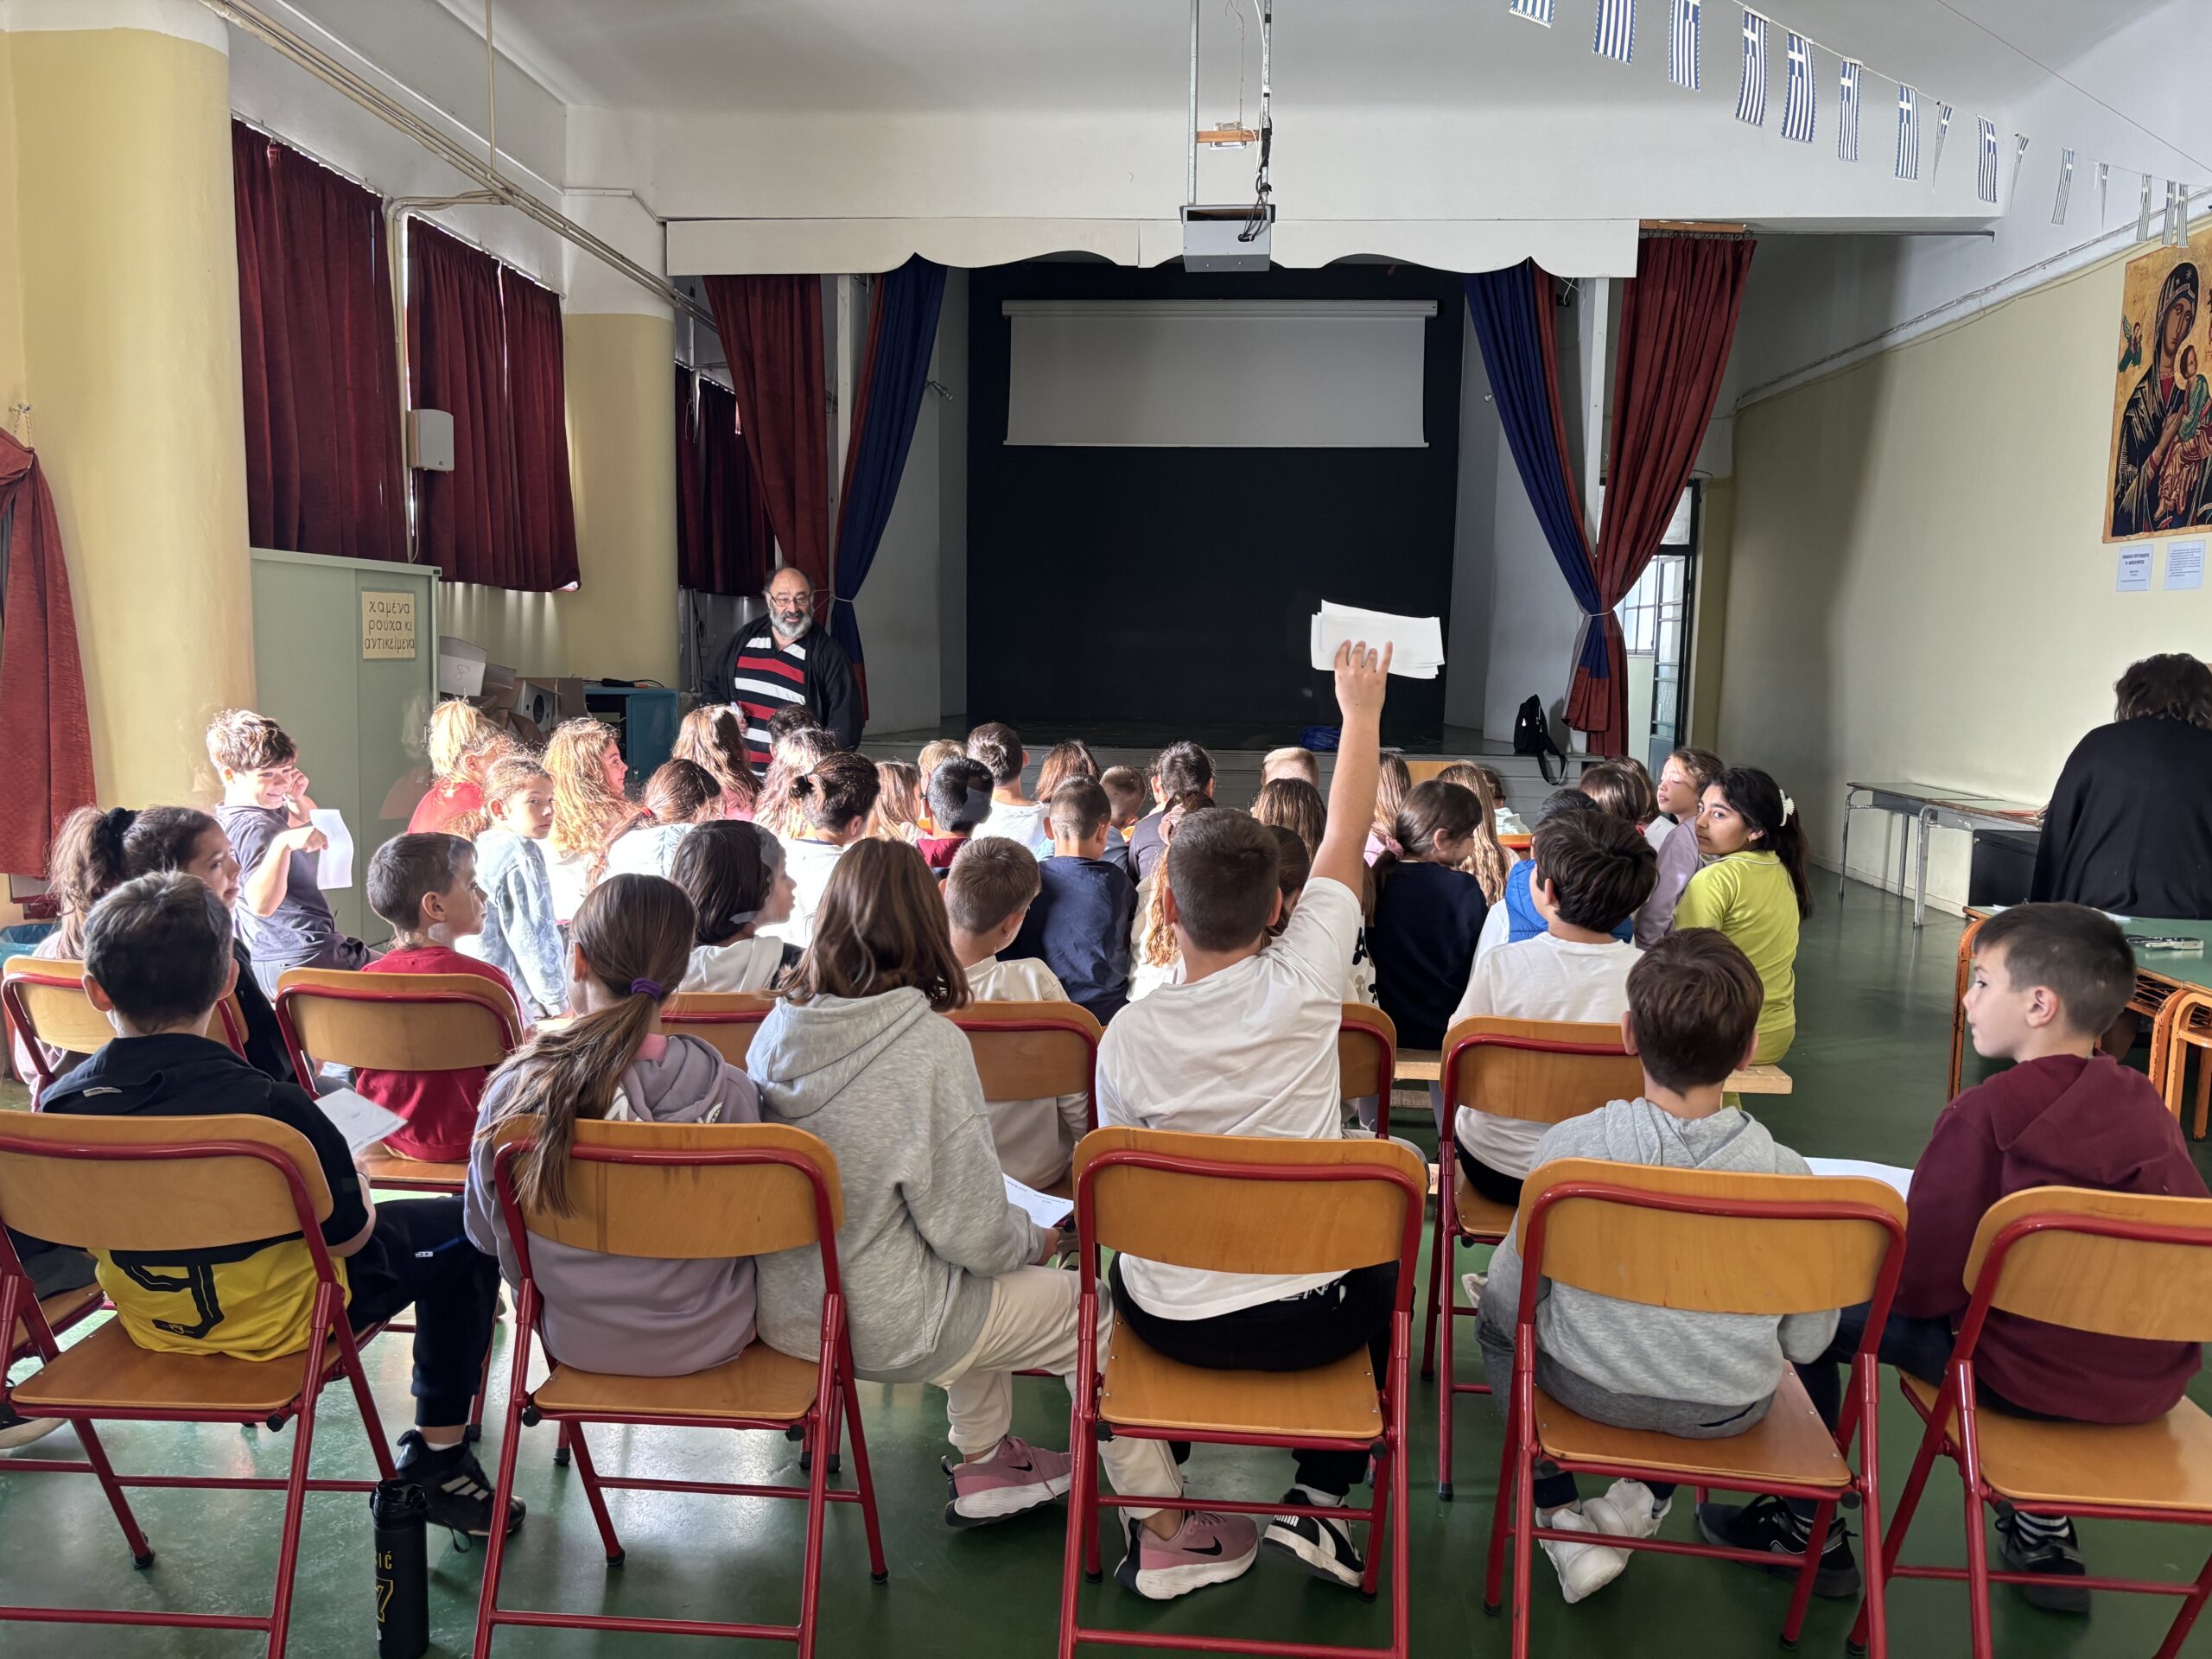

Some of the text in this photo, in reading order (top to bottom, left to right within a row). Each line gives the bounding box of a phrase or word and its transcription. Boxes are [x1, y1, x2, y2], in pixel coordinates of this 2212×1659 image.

[369, 600, 410, 617] χαμένα
[368, 618, 412, 635] ρούχα κι
[365, 636, 415, 654] αντικείμενα
[375, 1551, 392, 1570] IĆ
